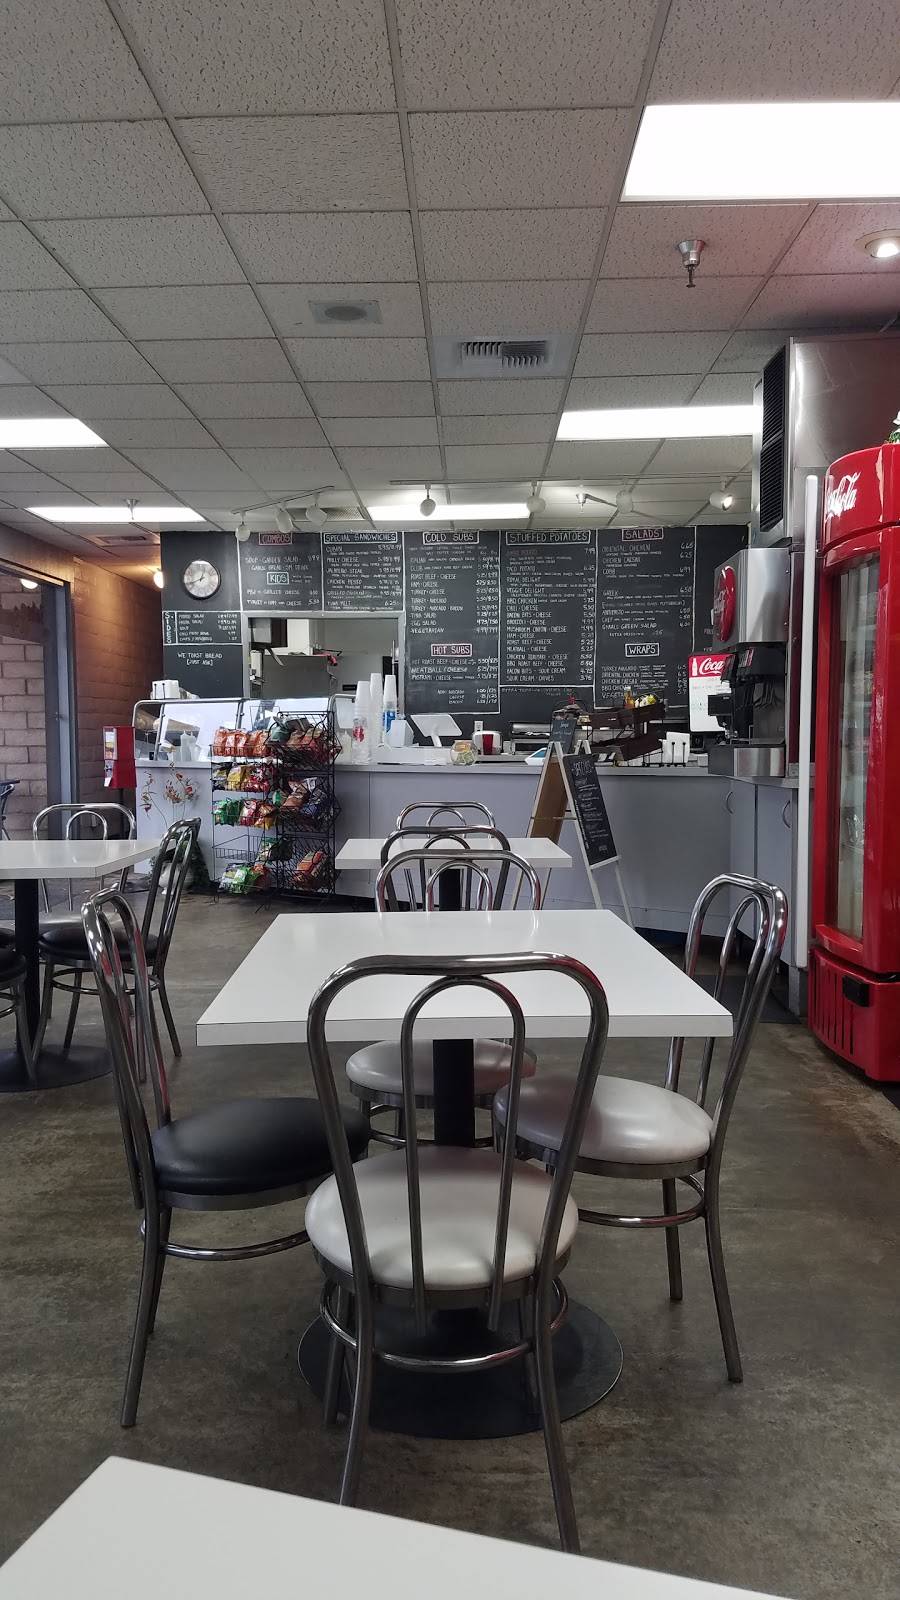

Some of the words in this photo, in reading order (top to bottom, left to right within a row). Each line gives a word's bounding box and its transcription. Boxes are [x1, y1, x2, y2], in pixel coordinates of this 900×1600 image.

[326, 534, 351, 542] SPECIAL
[354, 532, 396, 542] SANDWICHES
[425, 533, 447, 542] COLD
[452, 533, 474, 542] SUBS
[509, 533, 547, 543] STUFFED
[549, 531, 588, 541] POTATOES
[625, 529, 660, 539] SALADS
[262, 534, 290, 544] COMBOS
[629, 543, 651, 551] CHICKEN
[602, 556, 622, 564] CHICKEN
[270, 573, 287, 583] KIDS
[506, 597, 516, 605] BBQ
[529, 618, 546, 626] CHEESE
[620, 622, 638, 630] GREEN
[550, 625, 567, 633] CHEESE
[433, 646, 448, 655] HOT
[451, 646, 470, 654] SUBS
[628, 645, 656, 655] WRAPS
[699, 657, 726, 676] Coca
